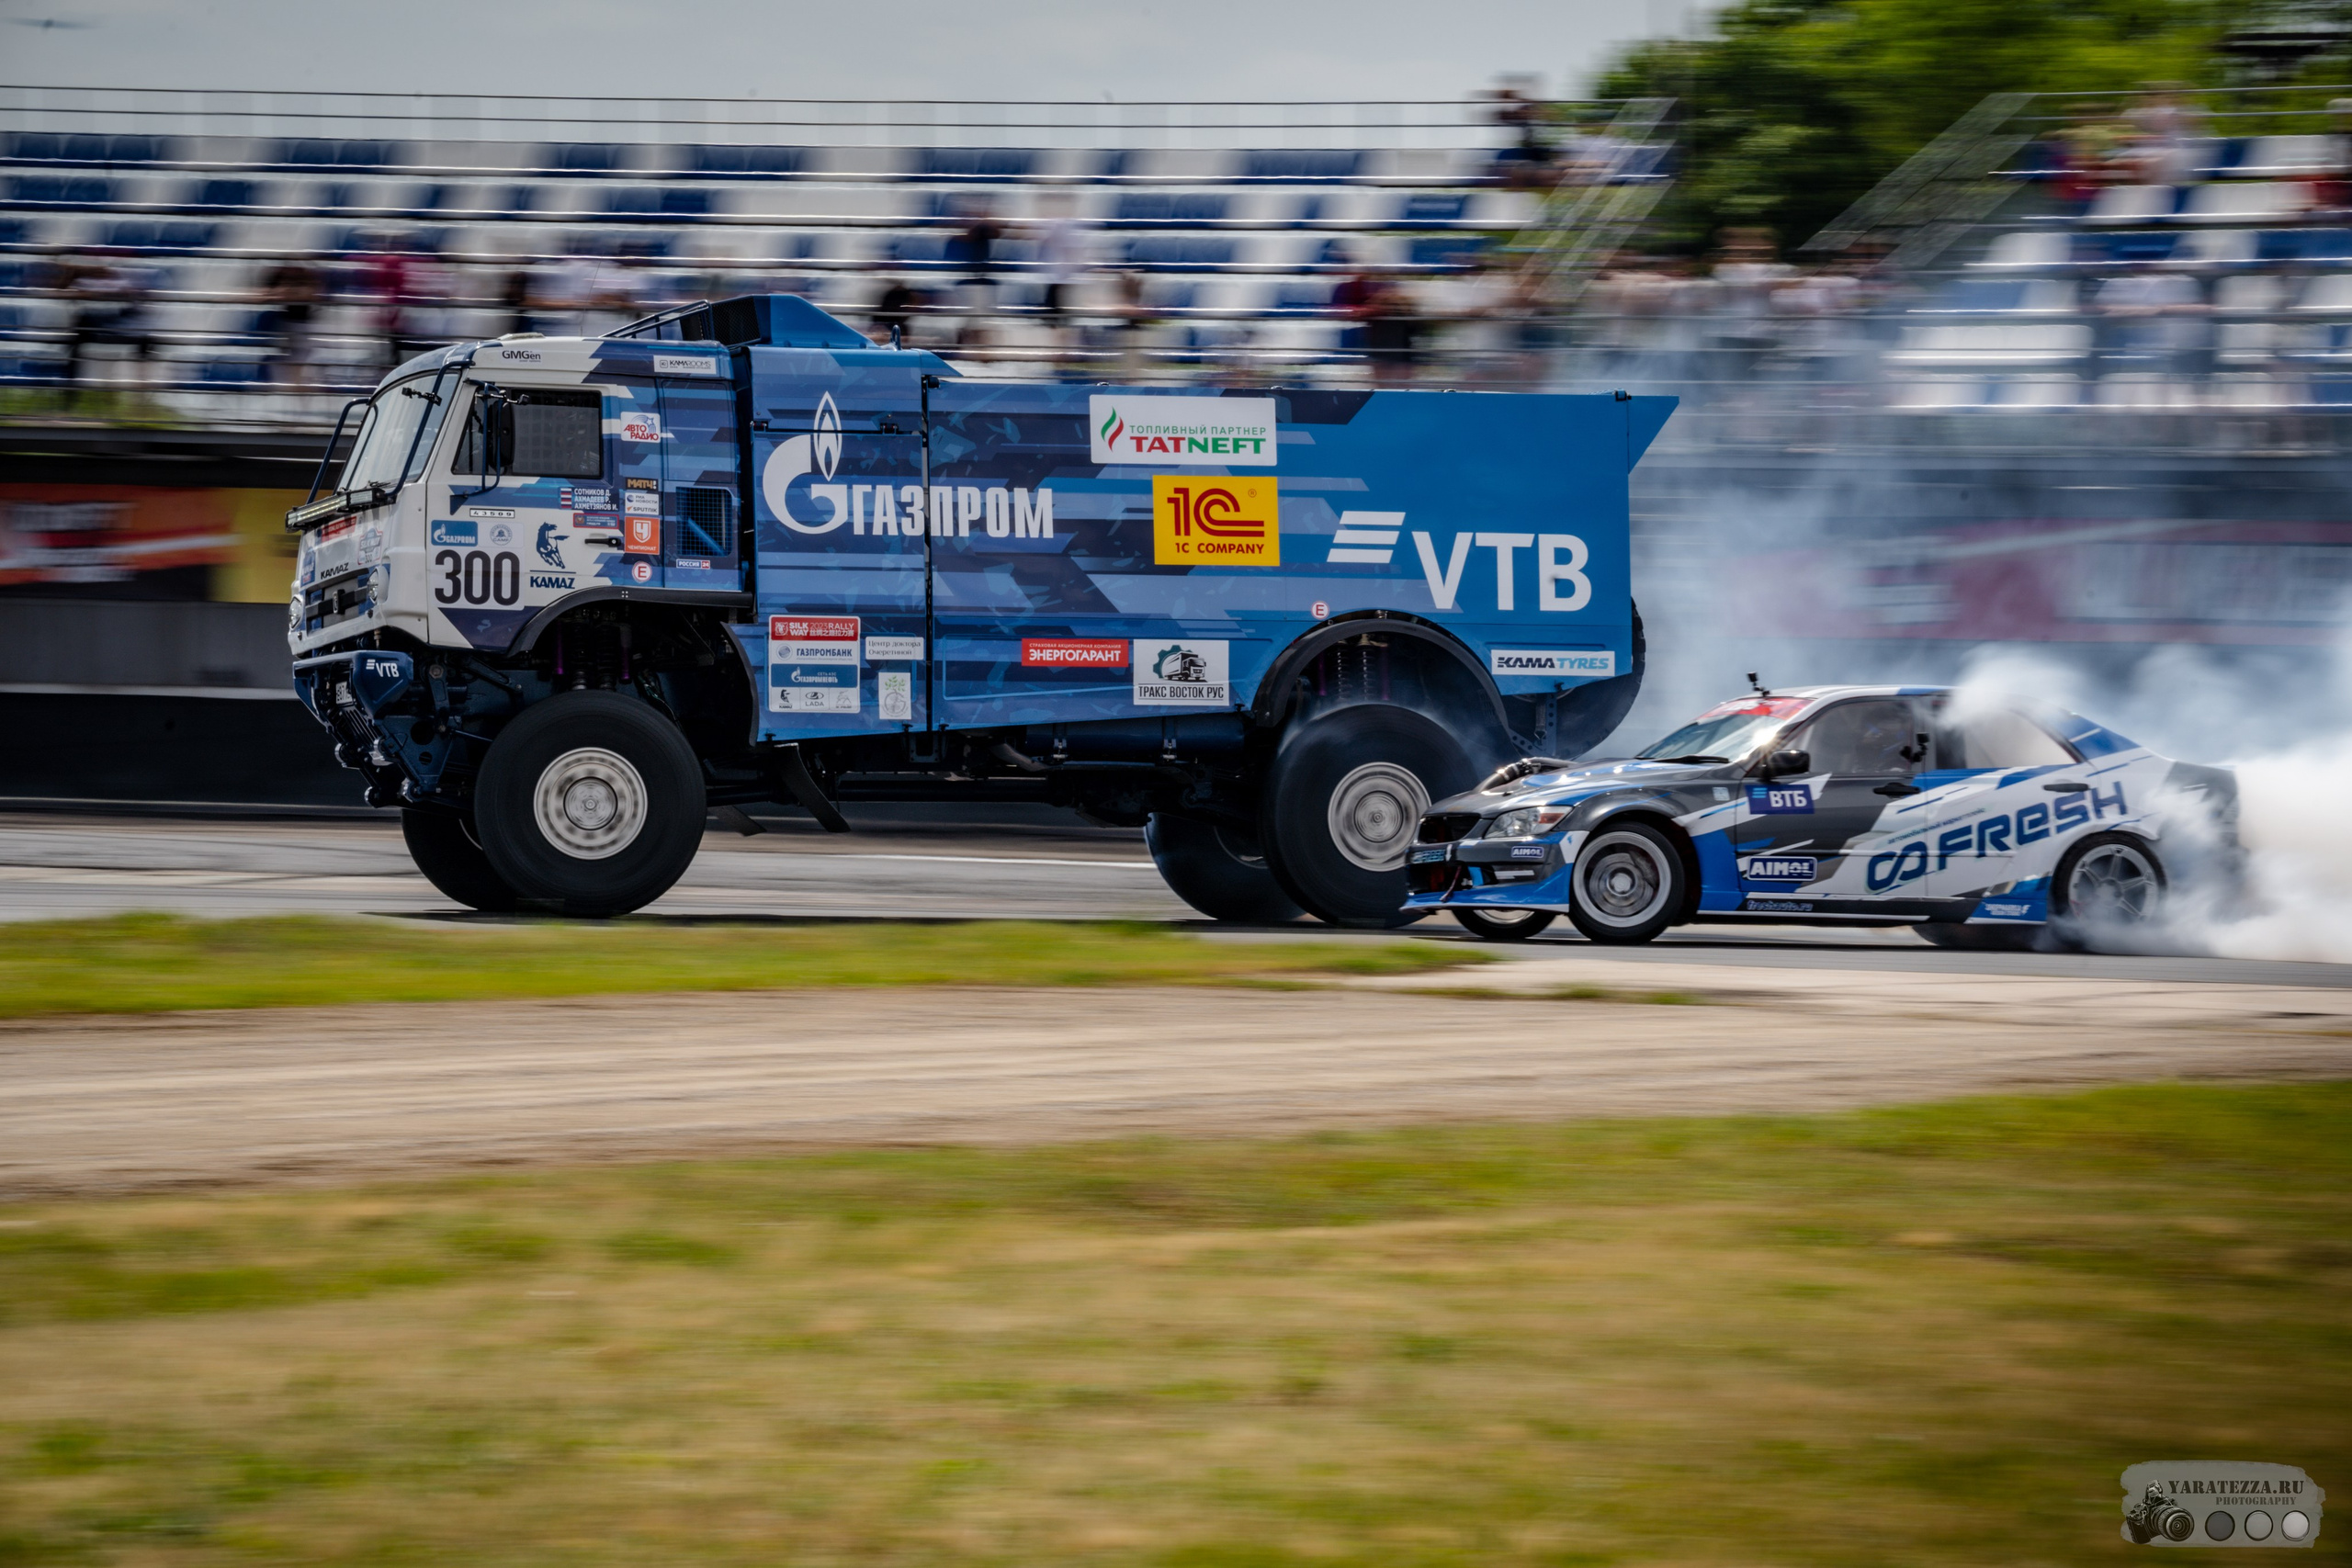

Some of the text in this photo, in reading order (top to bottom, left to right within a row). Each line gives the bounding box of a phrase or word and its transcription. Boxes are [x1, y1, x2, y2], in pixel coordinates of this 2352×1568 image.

[670, 359, 711, 367] KAMAROOMS
[623, 424, 648, 433] АВТО
[1129, 424, 1267, 435] ТОПЛИВНЫЙ ПАРТНЕР
[630, 432, 659, 441] РАДИО
[1129, 436, 1267, 454] TATNEFT
[574, 488, 605, 496] СОТНИКОВ
[574, 495, 605, 503] АХМАДЕЕВ
[574, 502, 613, 511] АХМЕТЗЯНОВ
[853, 484, 1054, 539] ГАЗПРОМ
[1167, 488, 1265, 537] 1C
[445, 536, 476, 544] GAZPROM
[1175, 543, 1265, 554] 1C COMPANY
[321, 562, 349, 580] KAMAZ
[1411, 531, 1592, 612] VTB
[435, 549, 520, 606] 300
[530, 576, 576, 589] KAMAZ
[868, 640, 922, 649] Центр доктора
[797, 648, 853, 657] ГАЗПРОМБАНК
[868, 649, 912, 657] Очеретиной
[1029, 649, 1121, 661] ЭНЕРГОГАРАНТ
[1498, 656, 1609, 670] KAMA TYRES
[376, 662, 400, 678] VTB
[1138, 685, 1225, 699] ТРАКС ВОСТОК РУС
[1769, 790, 1807, 807] ВТБ
[1512, 849, 1543, 857] AIMOL
[1750, 862, 1814, 875] AIMOL
